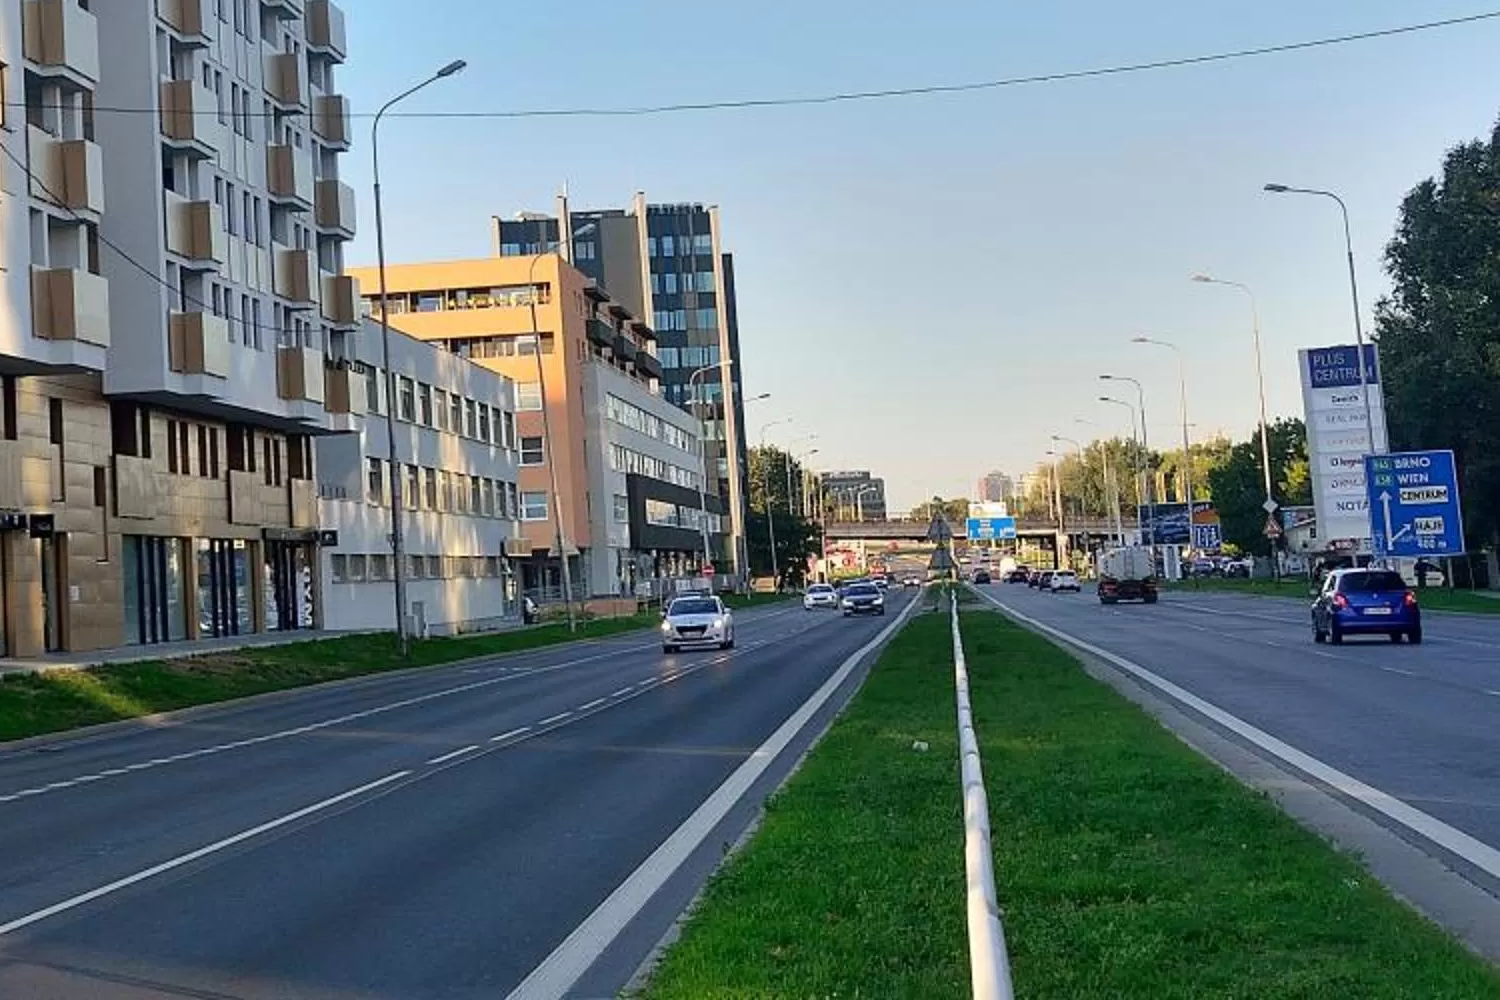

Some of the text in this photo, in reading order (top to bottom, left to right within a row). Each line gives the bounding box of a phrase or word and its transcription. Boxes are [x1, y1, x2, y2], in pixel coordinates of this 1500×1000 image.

[1313, 352, 1346, 366] PLUS
[1394, 456, 1431, 469] BRNO
[1397, 473, 1429, 484] WIEN
[1401, 489, 1447, 501] CENTRUM
